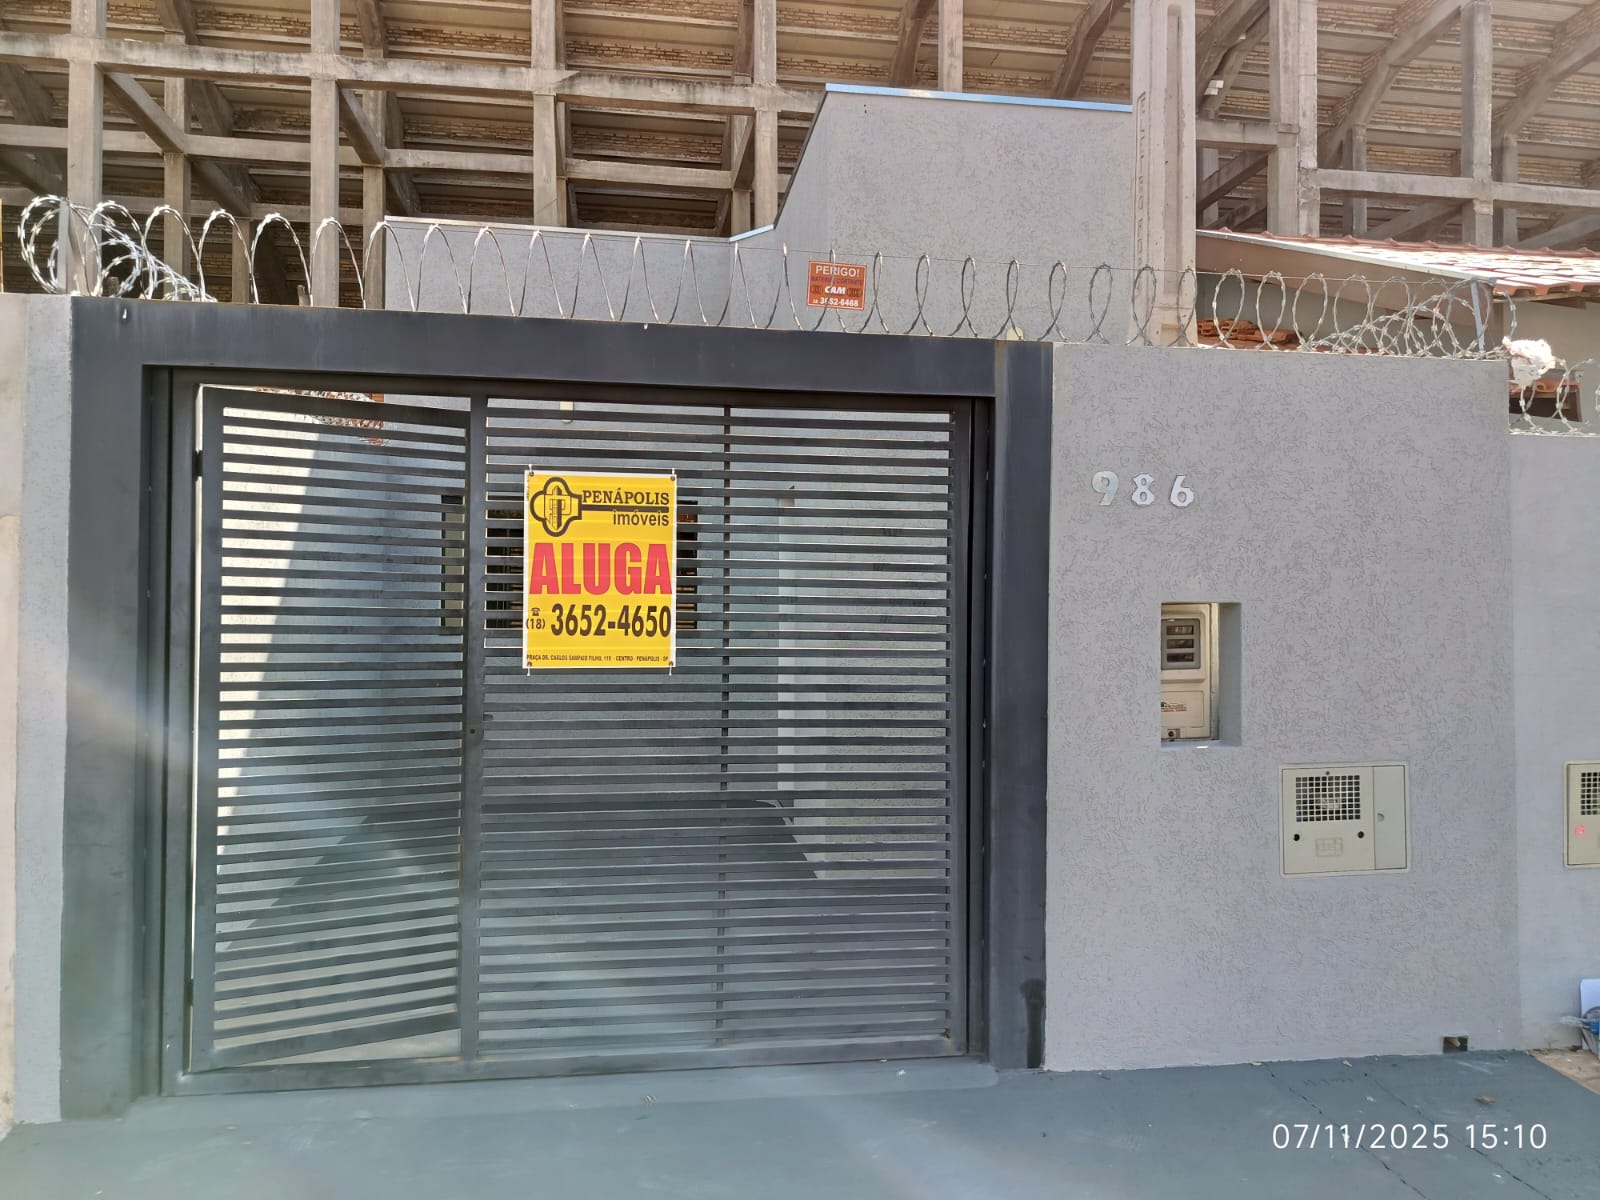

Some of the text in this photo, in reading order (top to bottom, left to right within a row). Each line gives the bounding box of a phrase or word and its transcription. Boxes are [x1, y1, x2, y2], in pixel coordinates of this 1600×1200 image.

[816, 265, 860, 277] PERIGO!
[824, 286, 846, 295] CAM
[582, 488, 669, 505] PENÁPOLIS
[1091, 470, 1194, 507] 986
[613, 510, 669, 526] imóveis
[529, 542, 672, 595] ALUGA
[526, 603, 671, 637] (18) 3652-4650
